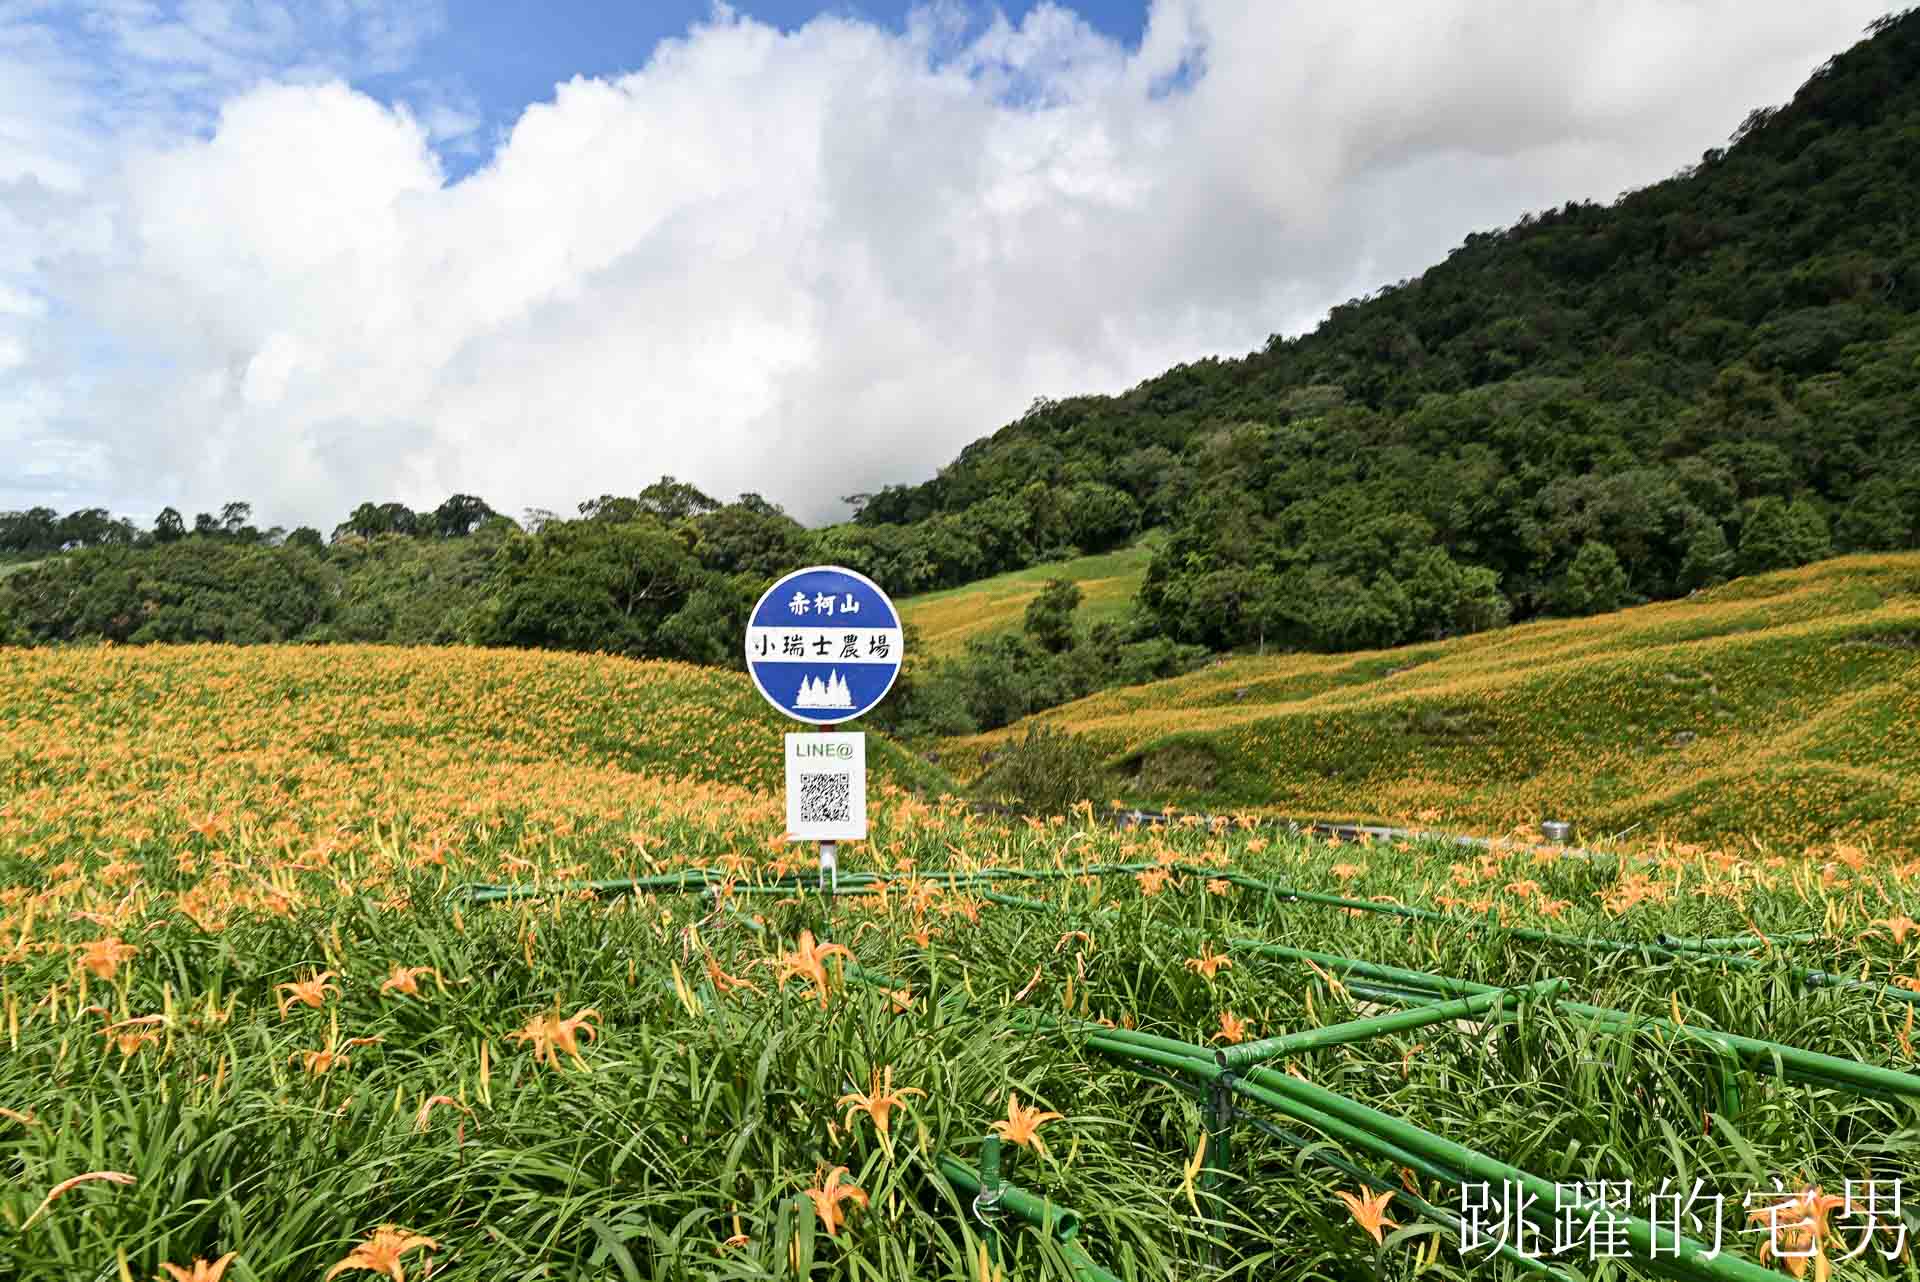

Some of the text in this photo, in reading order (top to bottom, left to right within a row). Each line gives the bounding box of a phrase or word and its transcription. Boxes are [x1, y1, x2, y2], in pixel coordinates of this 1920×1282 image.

[788, 591, 861, 617] 赤柯山
[754, 633, 891, 659] 小瑞士農場
[795, 742, 855, 761] LINE@
